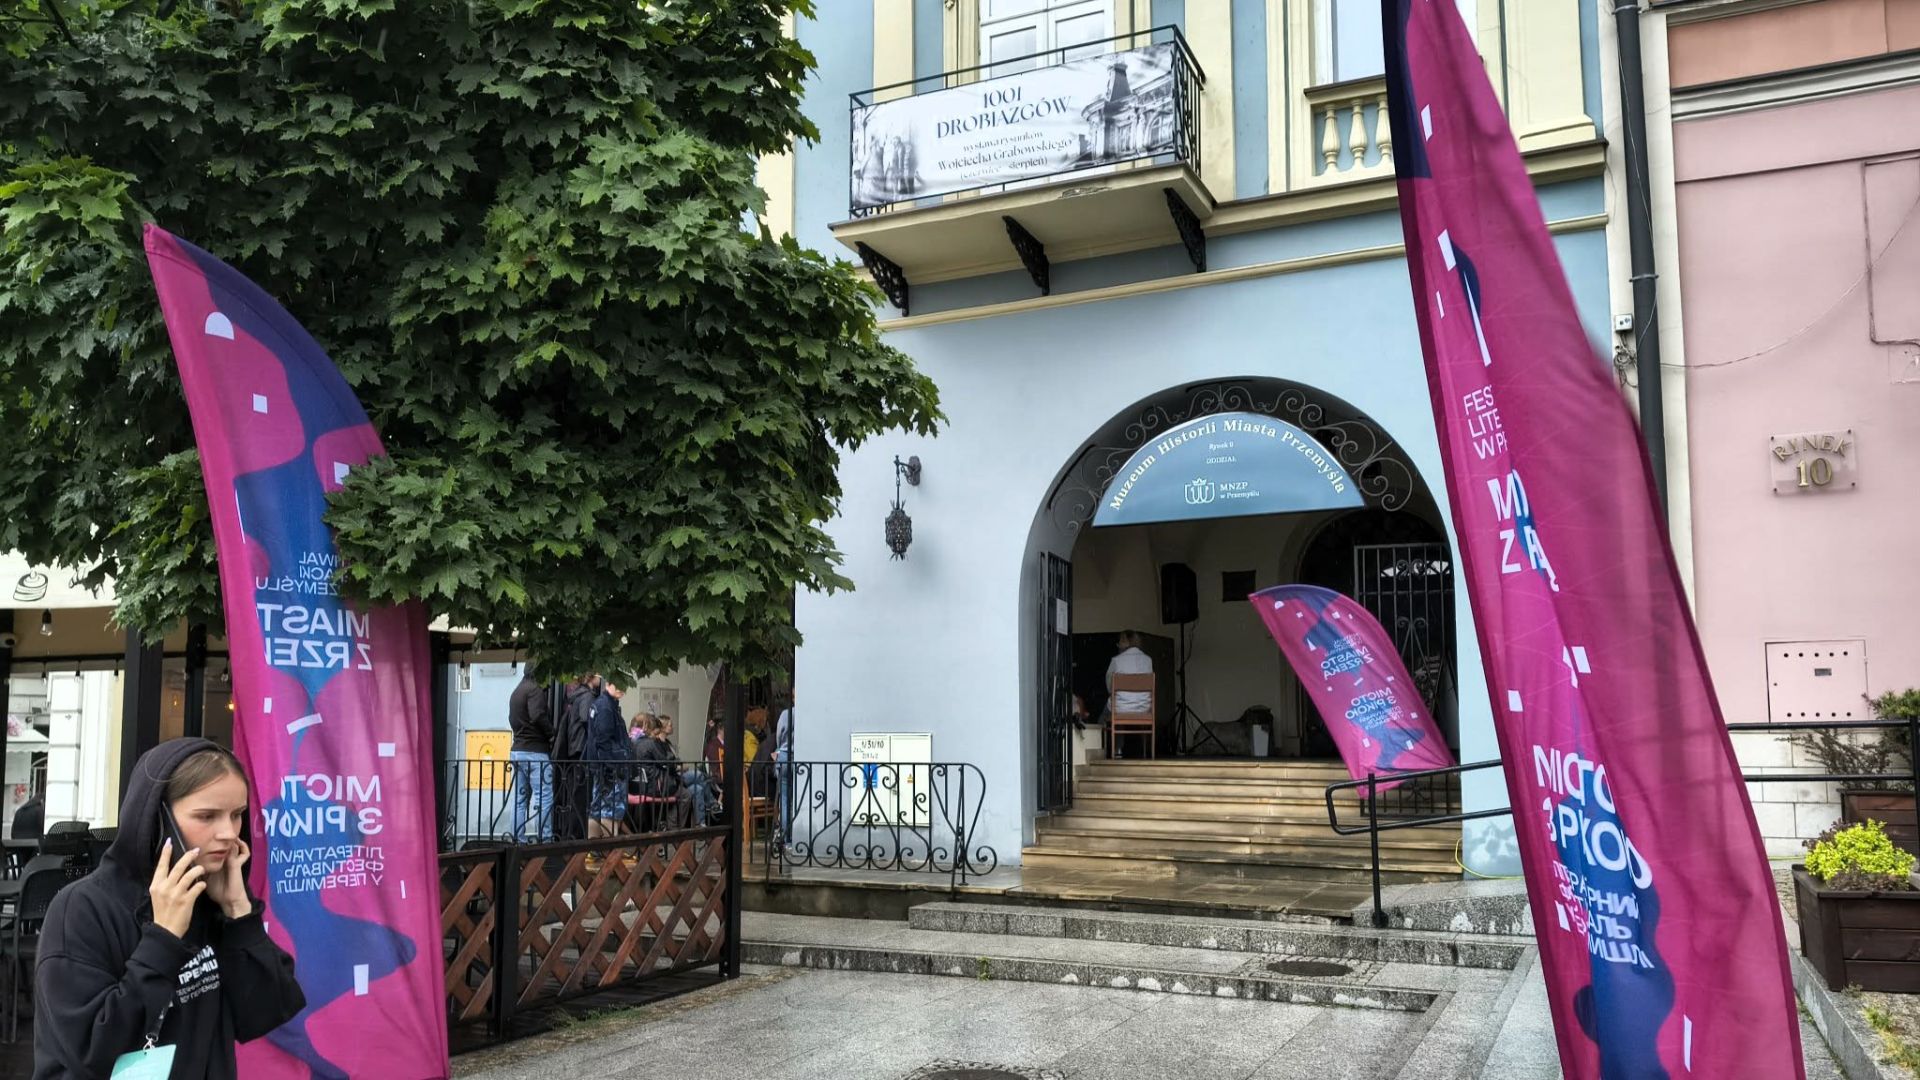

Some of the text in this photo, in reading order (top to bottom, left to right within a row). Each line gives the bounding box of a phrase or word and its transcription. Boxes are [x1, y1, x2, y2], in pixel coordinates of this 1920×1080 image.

[983, 86, 1021, 108] 1001
[937, 95, 1071, 138] DROBIAZGÓW
[993, 137, 1073, 161] Grabowskiego
[1463, 384, 1494, 416] FES
[1467, 408, 1502, 438] LITE
[1772, 434, 1852, 464] RYNEK
[1109, 419, 1345, 511] Muzeum Historii Miasta Przemyśla
[1796, 457, 1833, 487] 10
[1219, 481, 1248, 491] MNZP
